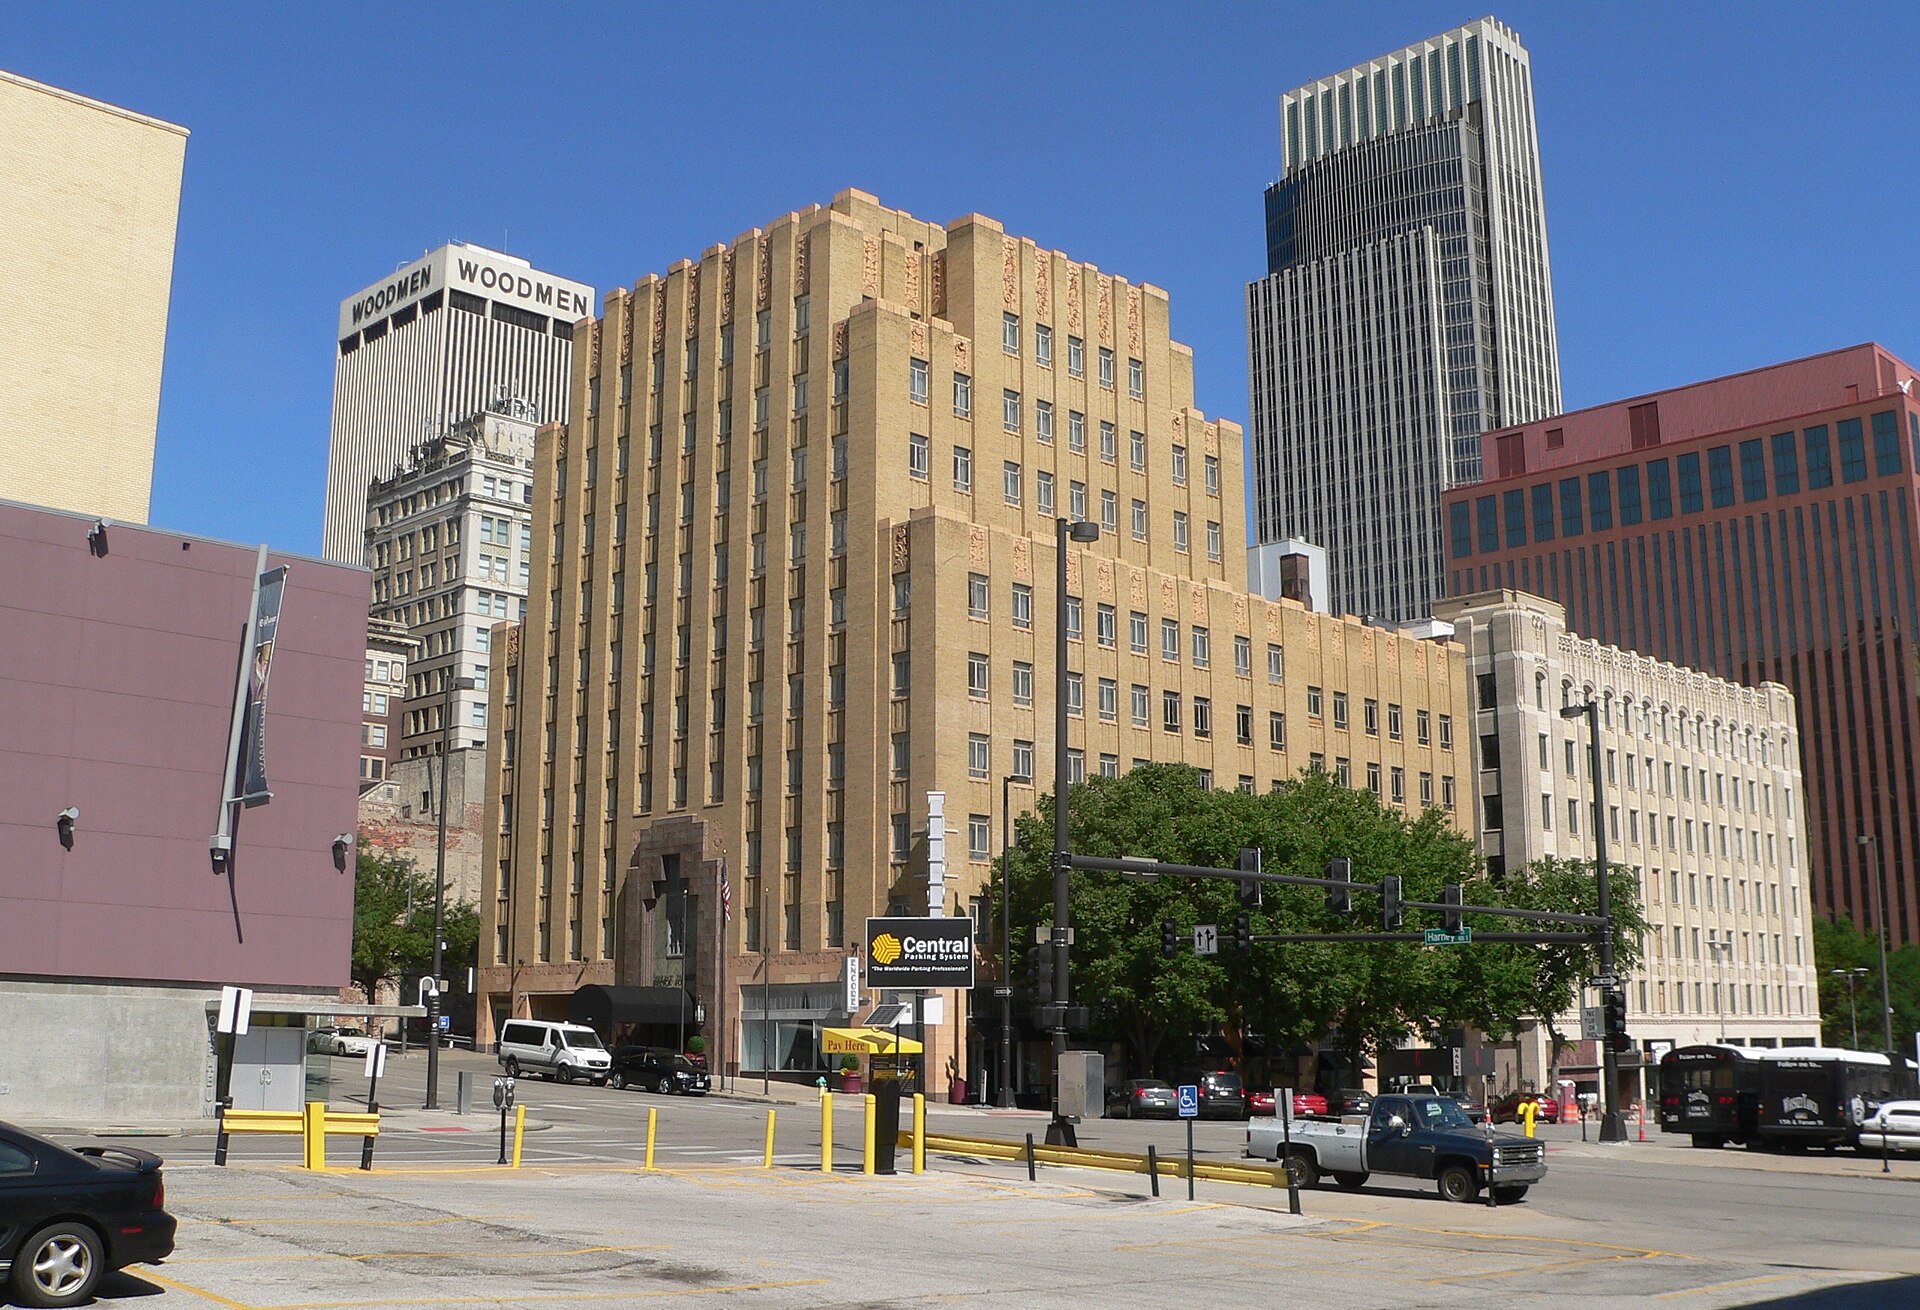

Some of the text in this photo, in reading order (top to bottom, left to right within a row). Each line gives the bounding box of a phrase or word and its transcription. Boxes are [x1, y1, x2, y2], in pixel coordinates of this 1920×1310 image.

[457, 257, 588, 317] WOODMEN
[352, 264, 432, 326] WOODMEN
[903, 936, 969, 953] Central
[1427, 932, 1455, 942] Harney
[904, 953, 969, 961] Parking System
[828, 1040, 865, 1053] Pay Here
